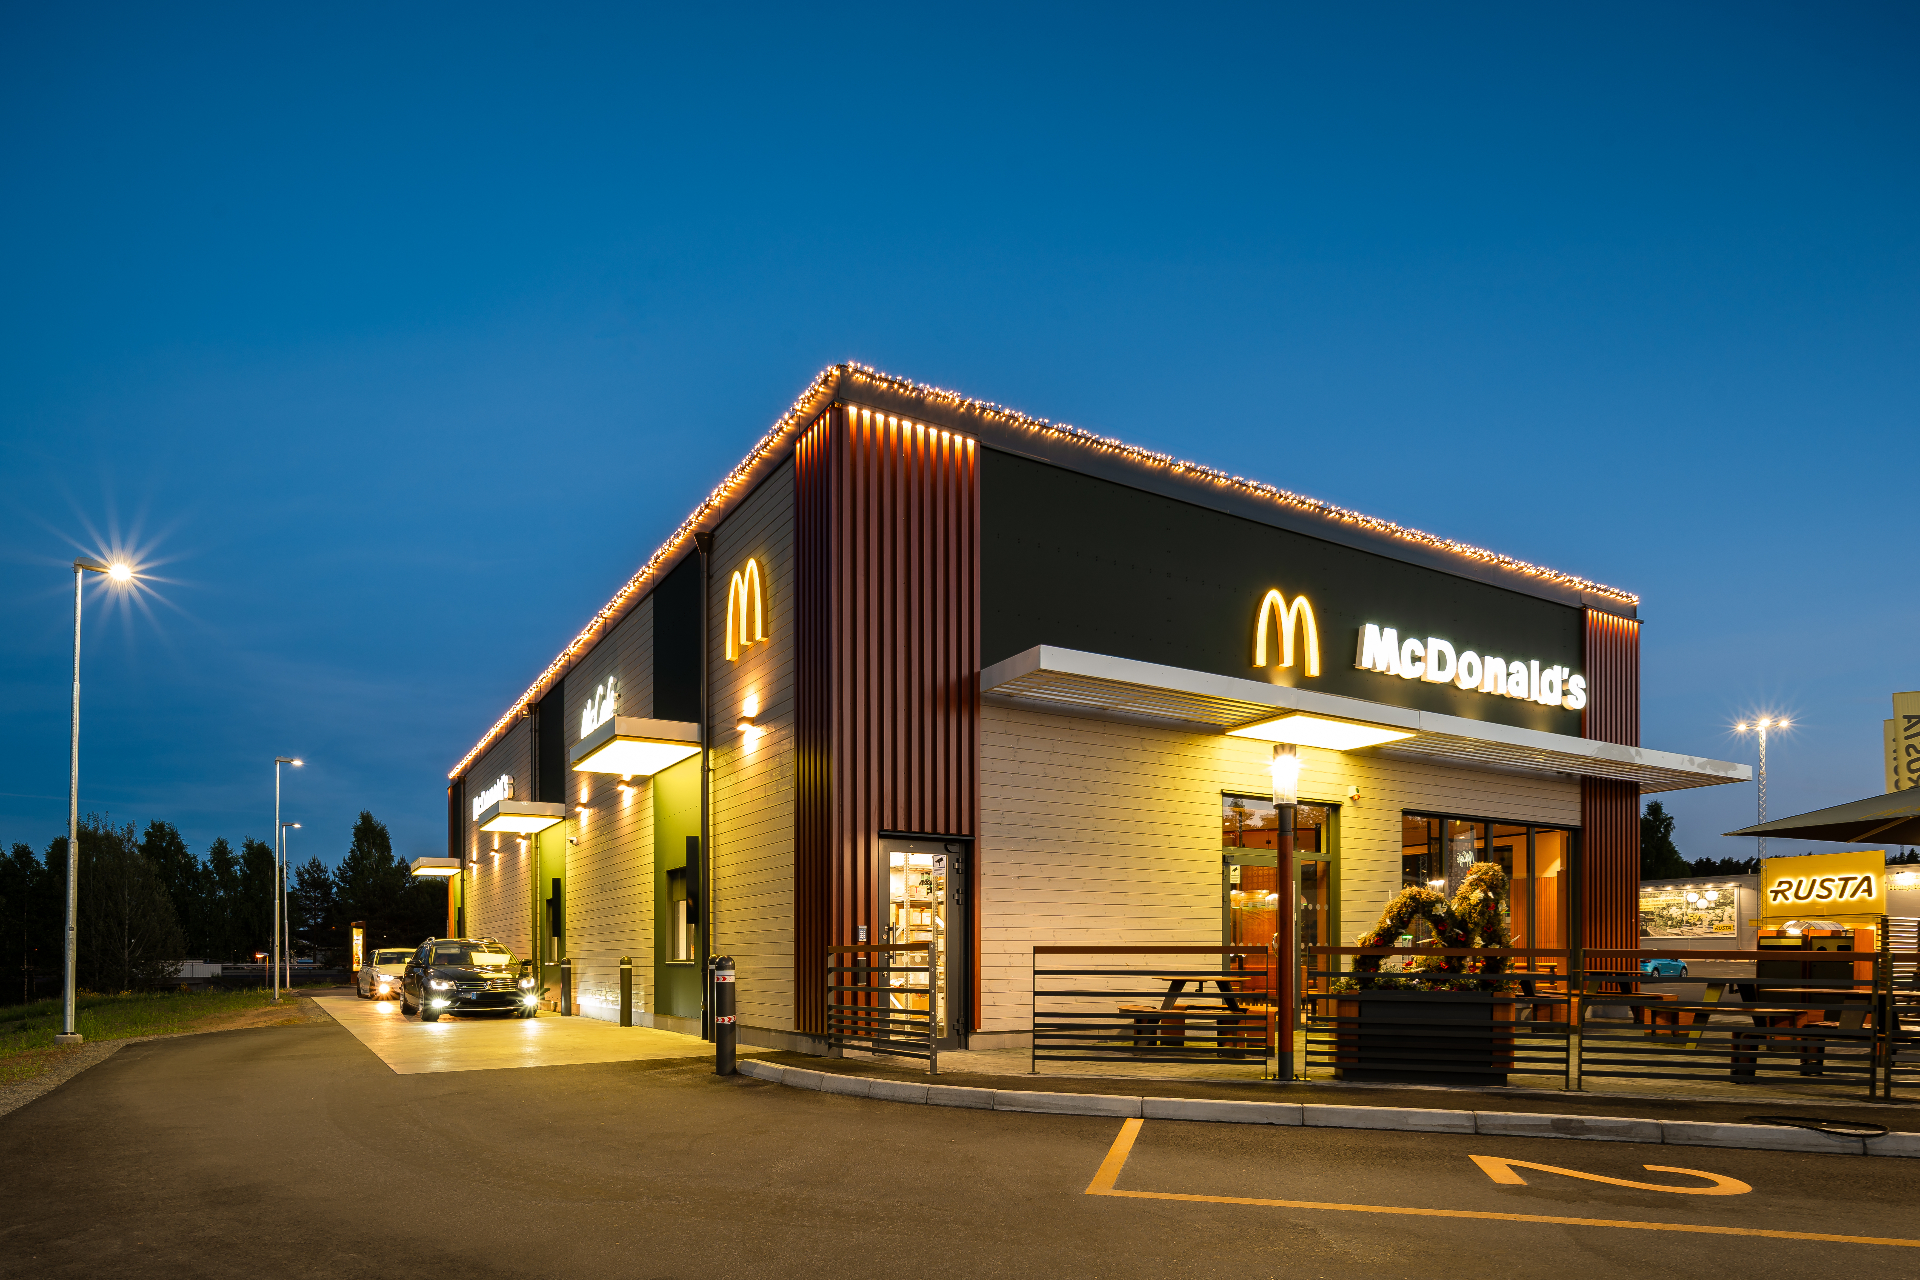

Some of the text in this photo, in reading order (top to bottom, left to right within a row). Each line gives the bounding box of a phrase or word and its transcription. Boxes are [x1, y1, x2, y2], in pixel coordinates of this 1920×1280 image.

[1355, 623, 1587, 711] McDonald's
[1770, 875, 1873, 902] RUSTA
[1468, 1154, 1753, 1196] 2
